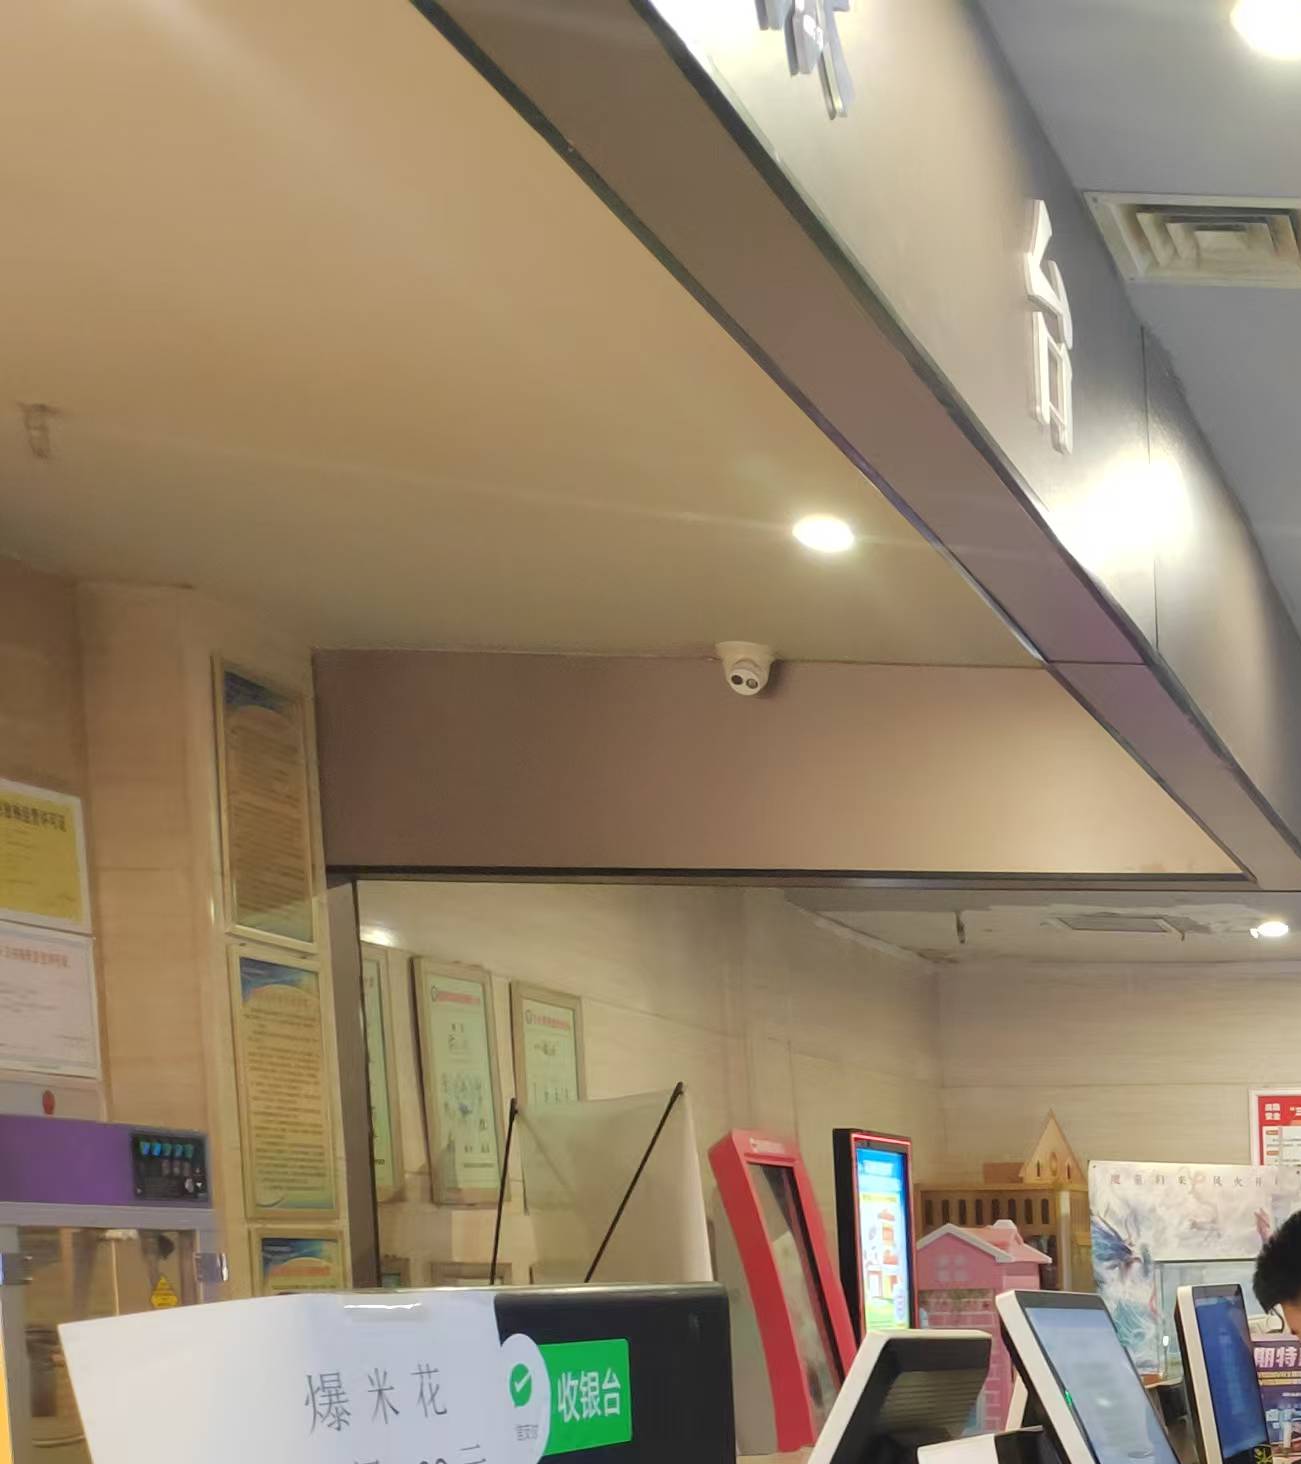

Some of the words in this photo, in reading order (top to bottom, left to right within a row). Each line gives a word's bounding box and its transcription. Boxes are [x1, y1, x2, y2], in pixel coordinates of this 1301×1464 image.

[305, 1363, 448, 1435] 爆米花
[557, 1367, 621, 1423] 收银台
